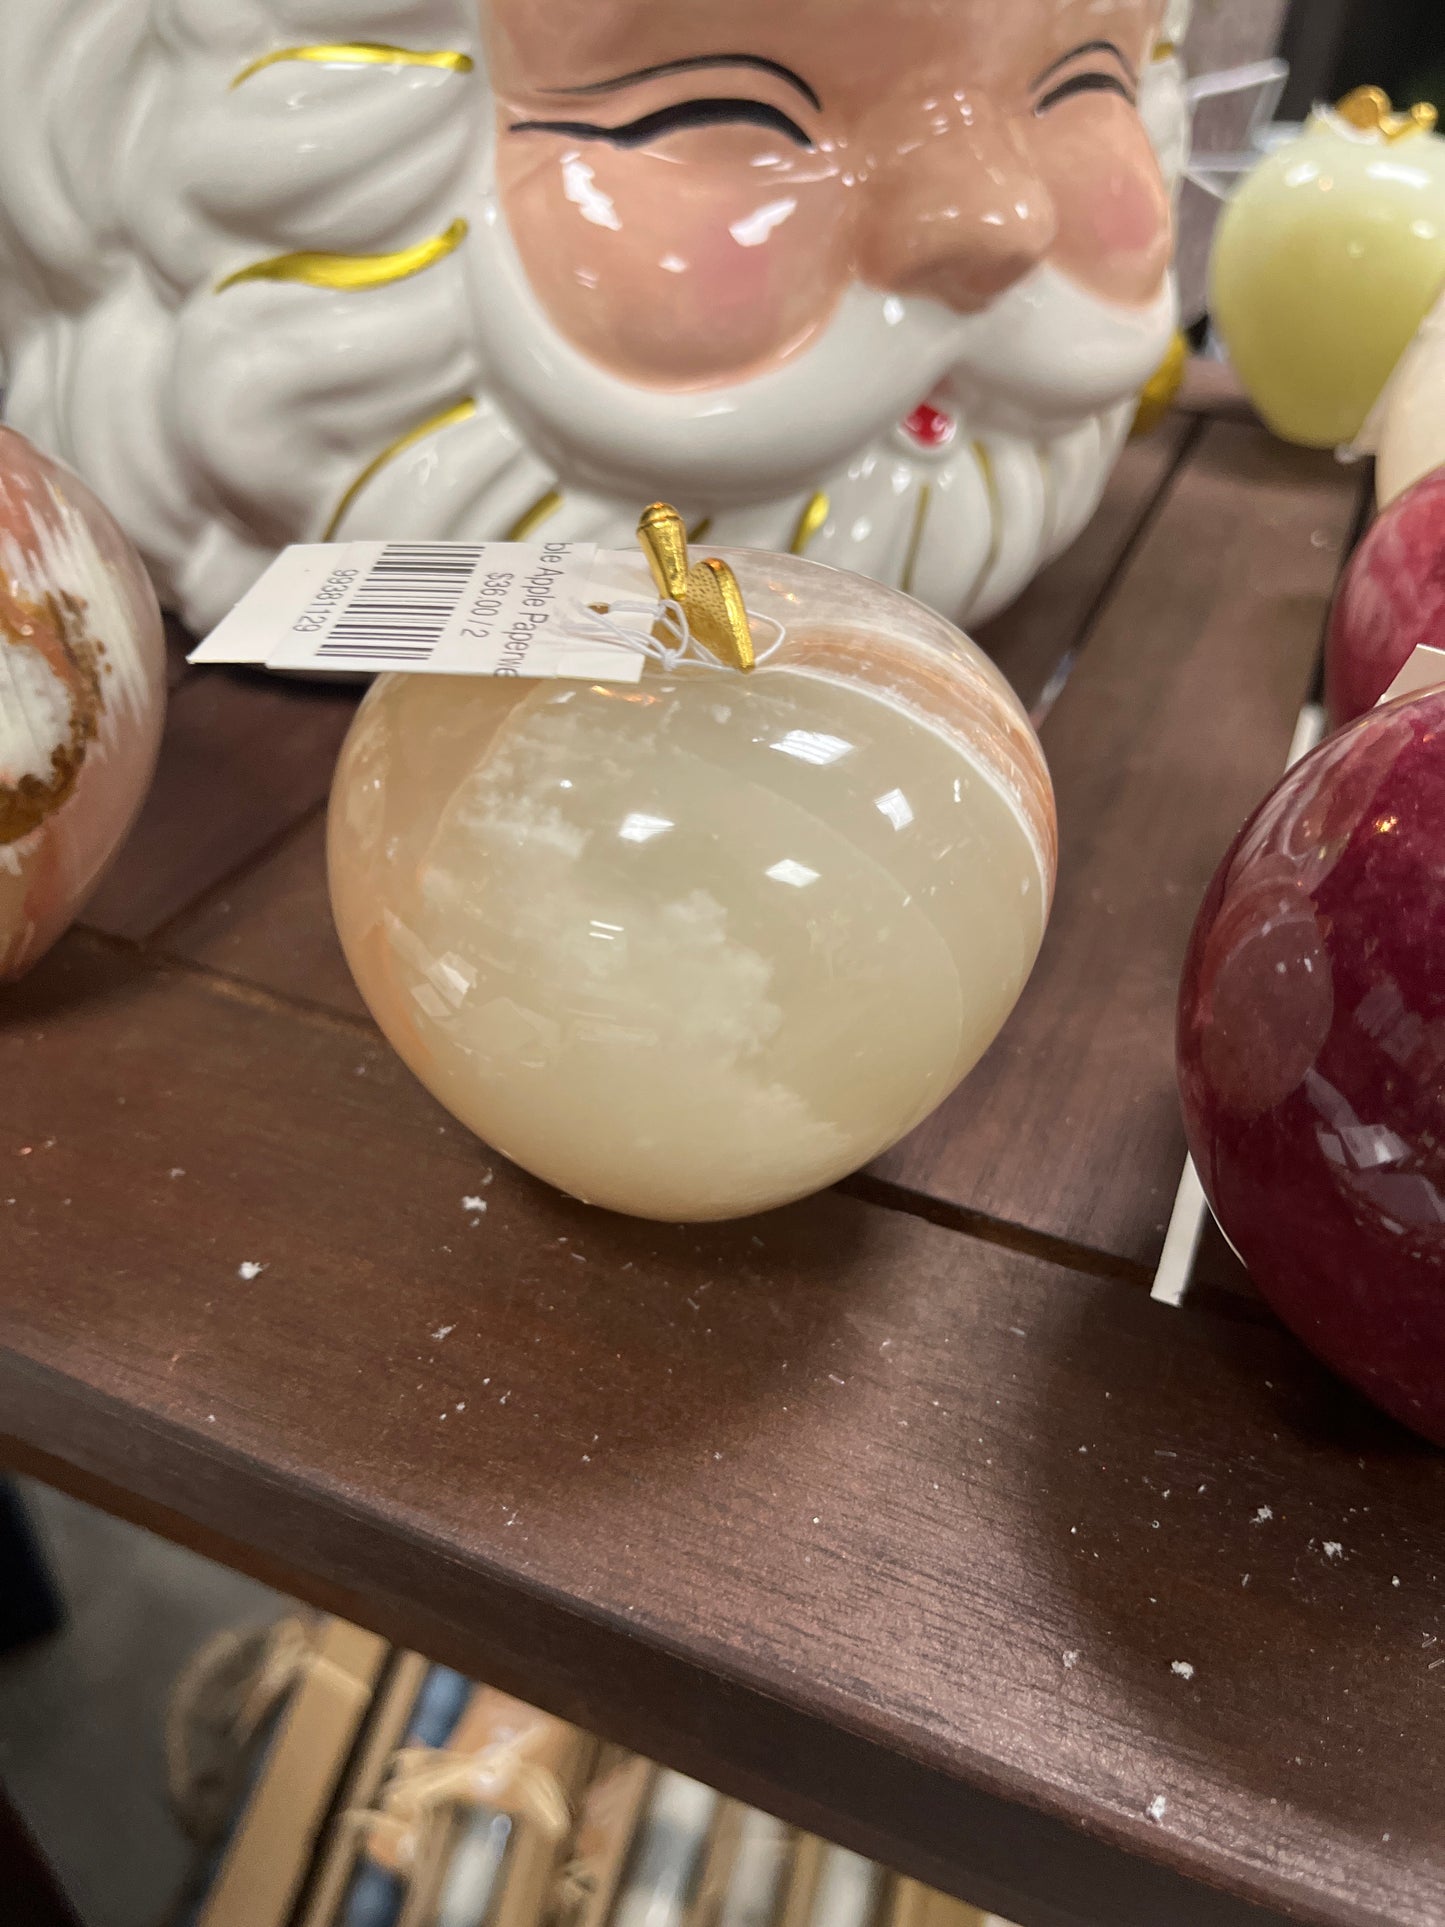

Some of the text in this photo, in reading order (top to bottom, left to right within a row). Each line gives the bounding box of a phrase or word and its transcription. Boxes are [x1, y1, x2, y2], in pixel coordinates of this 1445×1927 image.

[292, 569, 359, 632] 99381129
[471, 572, 515, 617] $36.00
[521, 567, 565, 607] Apple
